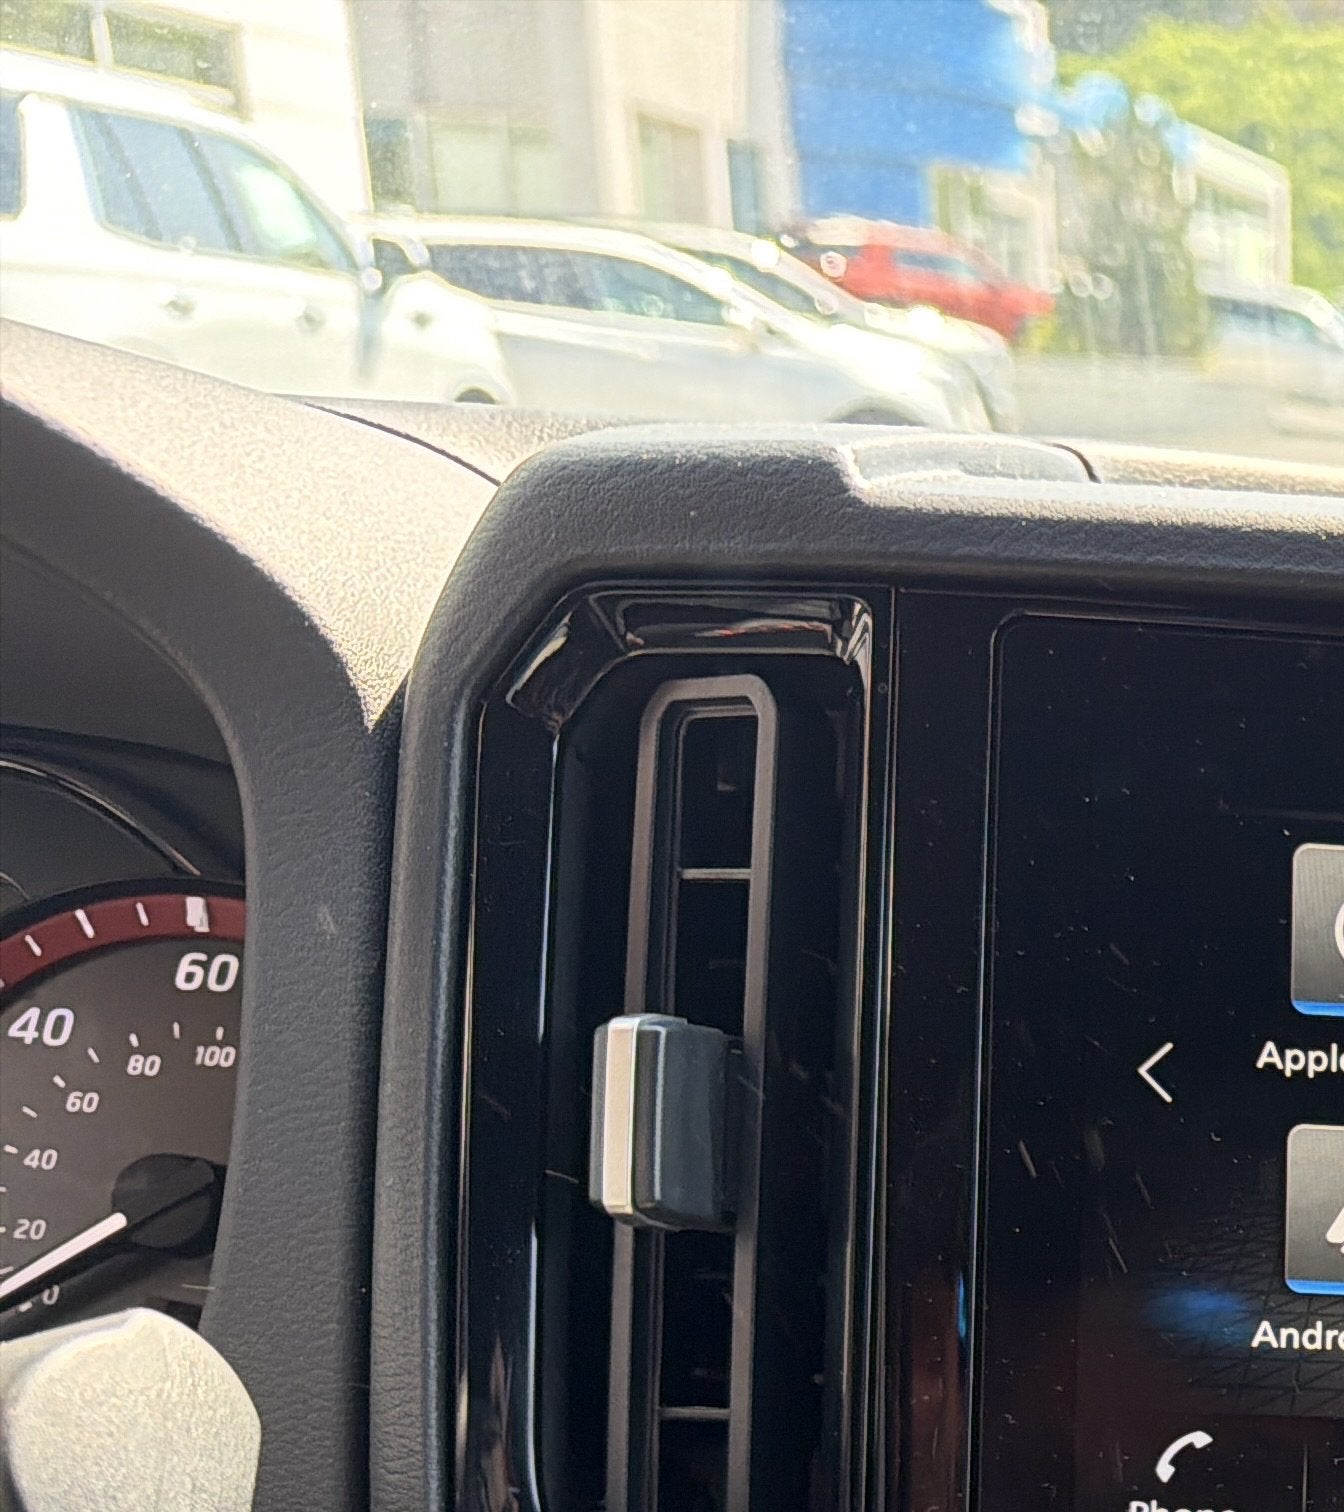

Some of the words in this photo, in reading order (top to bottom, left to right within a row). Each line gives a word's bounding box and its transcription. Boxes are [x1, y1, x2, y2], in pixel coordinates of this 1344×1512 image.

[175, 952, 239, 992] 60
[8, 1007, 75, 1047] 40
[126, 1054, 162, 1077] 80
[194, 1045, 237, 1068] 100
[65, 1091, 100, 1114] 60
[23, 1148, 58, 1171] 40
[13, 1218, 47, 1241] 20
